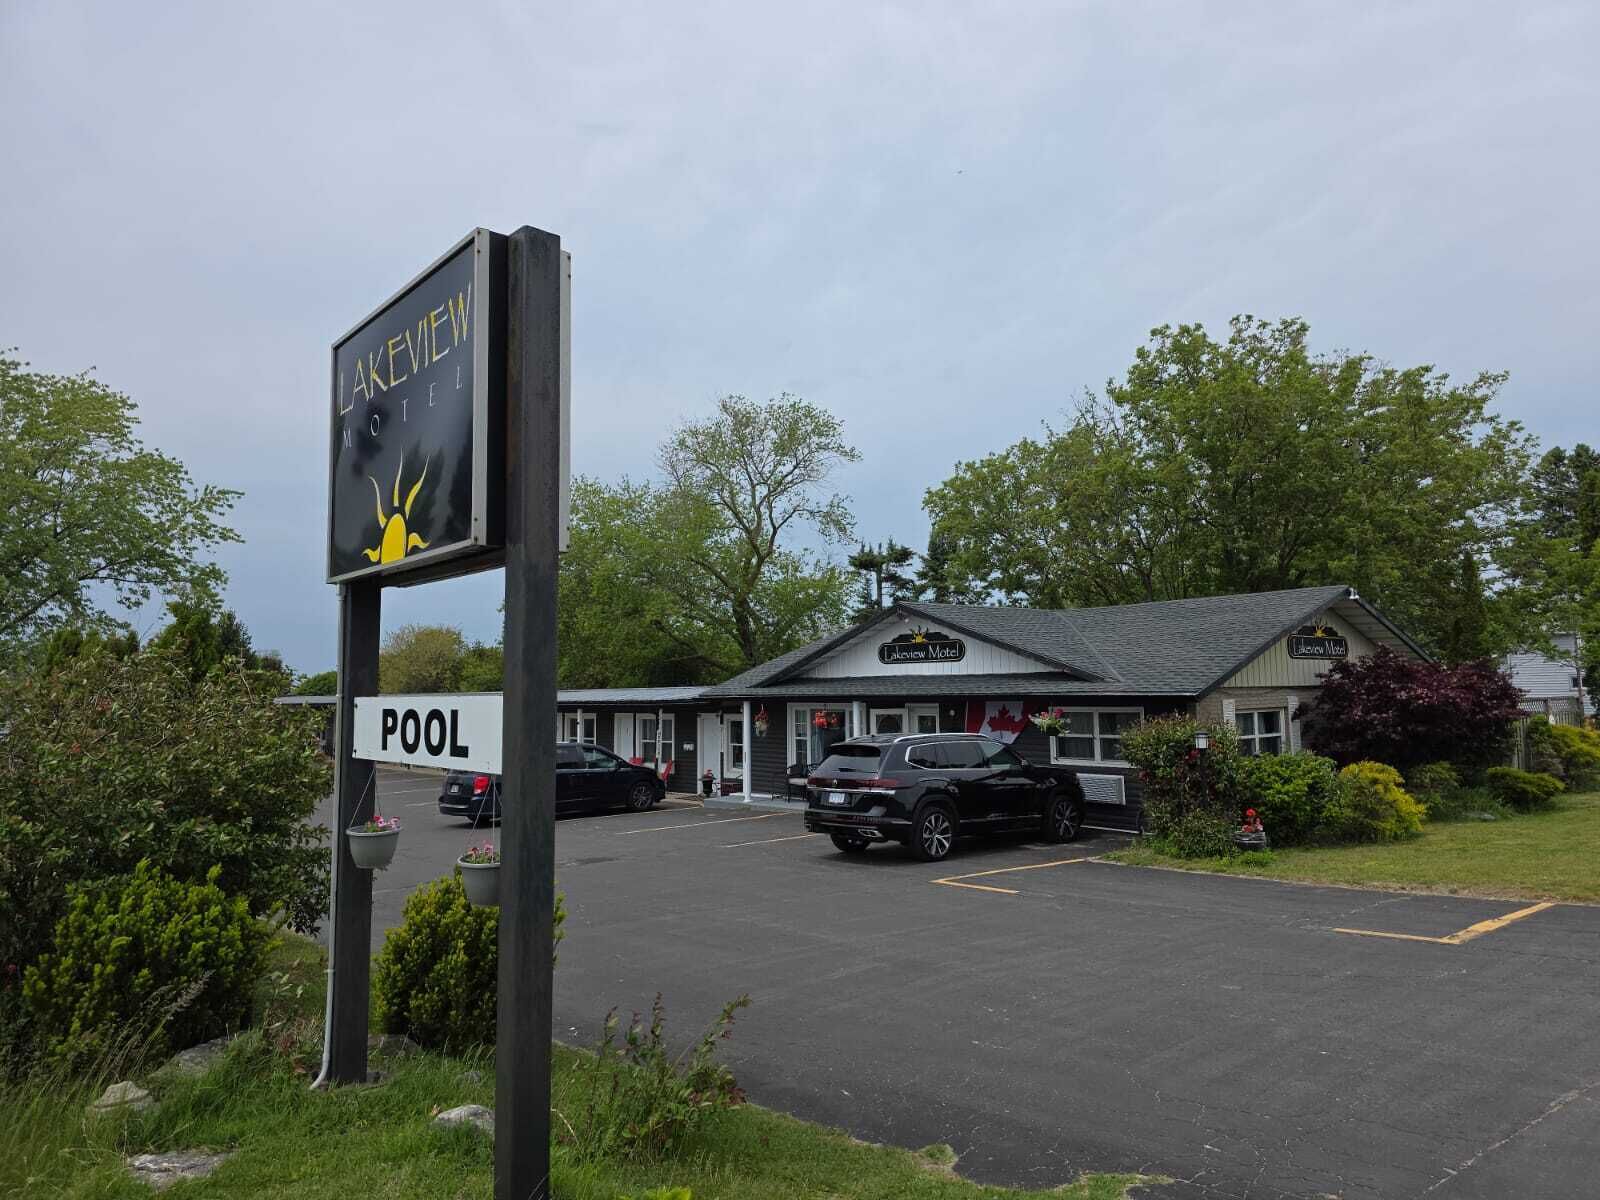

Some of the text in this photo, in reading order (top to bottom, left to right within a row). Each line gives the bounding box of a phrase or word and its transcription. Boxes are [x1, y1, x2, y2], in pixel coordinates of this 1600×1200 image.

[340, 280, 471, 416] LAKEVIEW
[884, 642, 959, 661] Lakeview Motel
[382, 708, 469, 758] POOL
